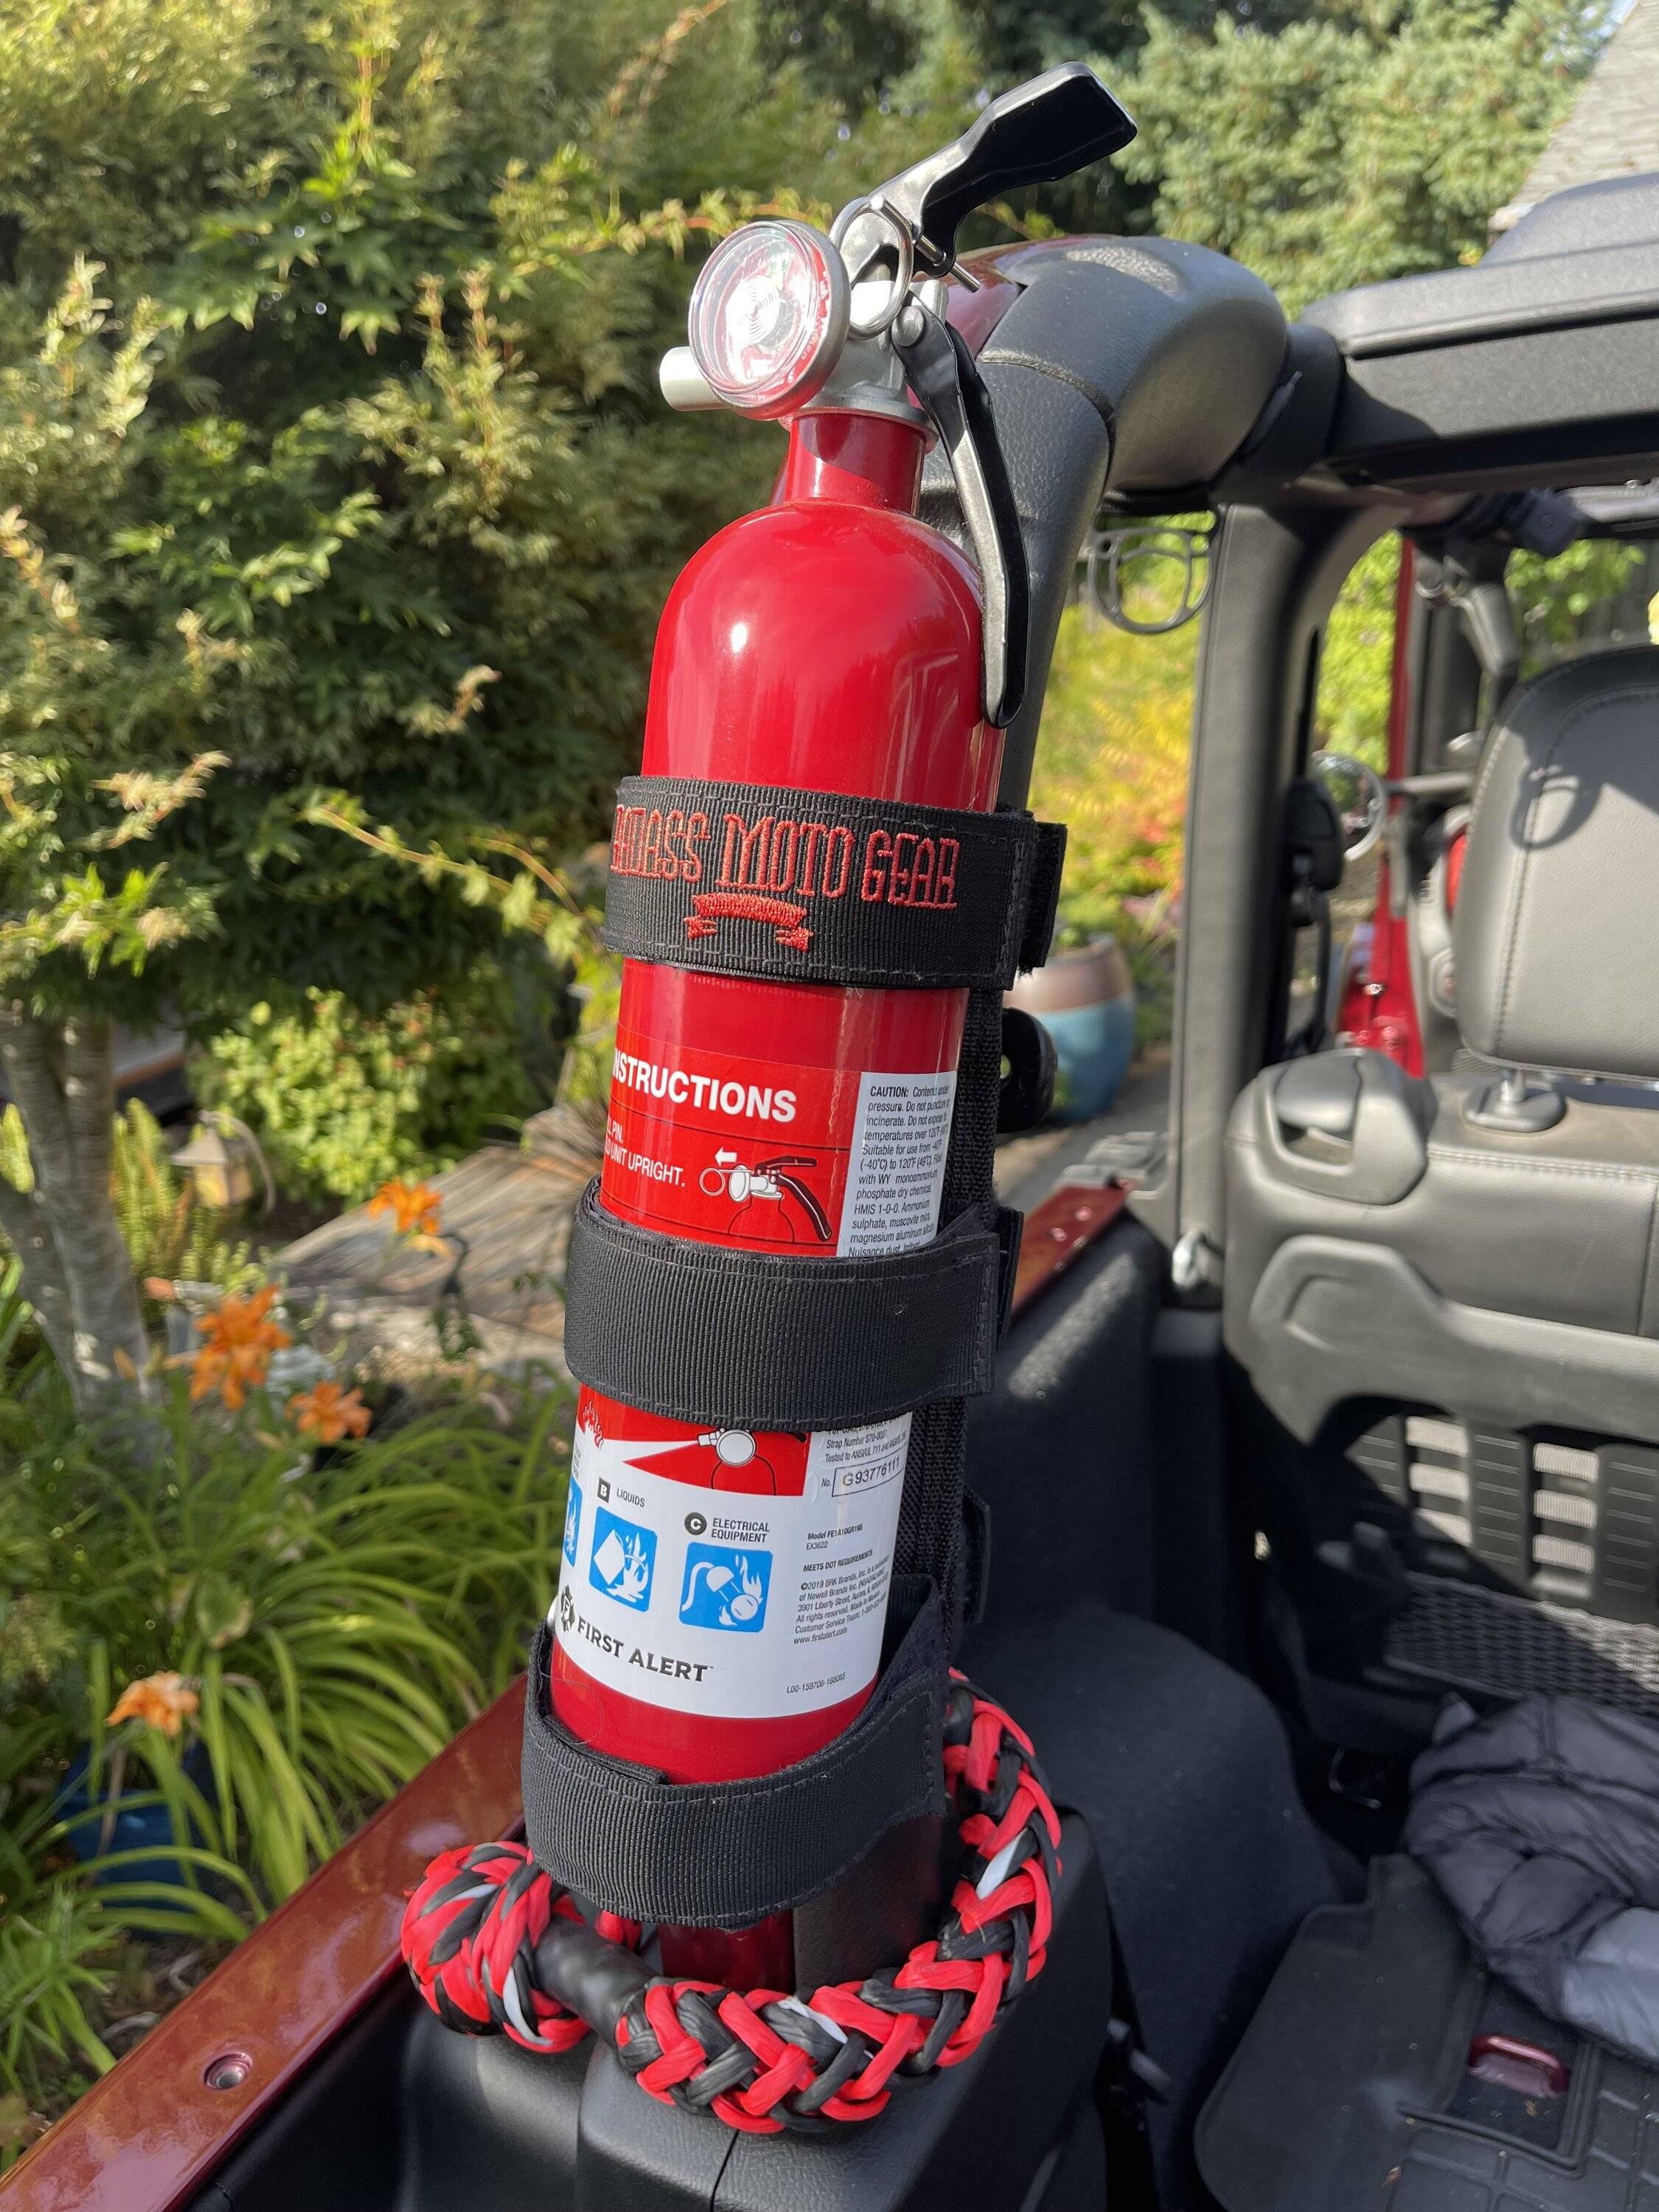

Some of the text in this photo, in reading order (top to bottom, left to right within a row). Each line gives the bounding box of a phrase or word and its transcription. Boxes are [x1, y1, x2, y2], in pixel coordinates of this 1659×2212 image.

[715, 813, 855, 898] MOTO
[861, 830, 960, 909] GEAR
[870, 1085, 909, 1098] CAUTION:
[913, 1085, 937, 1097] Contents
[868, 1102, 904, 1113] pressure.
[905, 1101, 914, 1112] Do
[917, 1101, 927, 1111] not
[866, 1114, 905, 1127] incinerate.
[908, 1115, 917, 1126] Do
[918, 1115, 928, 1125] not
[928, 1113, 943, 1125] expose
[611, 1120, 624, 1144] PIN.
[865, 1129, 914, 1142] temperatures
[915, 1130, 927, 1139] over
[863, 1144, 894, 1155] Suitable
[896, 1144, 905, 1155] for
[907, 1144, 917, 1154] use
[919, 1143, 931, 1153] from
[611, 1141, 627, 1166] UNIT
[627, 1151, 685, 1187] UPRIGHT.
[860, 1158, 888, 1172] (-40°C)
[889, 1159, 897, 1169] to
[899, 1157, 917, 1169] 120°F
[858, 1169, 938, 1185] with WY monoammonium
[856, 1188, 897, 1201] phosphate
[898, 1186, 908, 1200] dry
[854, 1199, 931, 1215] HMIS 1-0-0. Ammonium
[852, 1217, 888, 1231] sulphate,
[889, 1214, 919, 1228] muscovite
[850, 1233, 894, 1245] magnesium
[896, 1228, 922, 1242] aluminum
[849, 1245, 884, 1257] Nuisance
[827, 1439, 843, 1450] Strap
[844, 1435, 864, 1447] Number
[826, 1451, 844, 1463] Tested
[845, 1451, 851, 1460] to
[872, 1444, 881, 1455] 711
[821, 1477, 832, 1487] No.
[600, 1484, 645, 1508] B LIQUIDS
[690, 1517, 771, 1532] C ELECTRICAL
[711, 1528, 768, 1543] EQUIPMENT
[807, 1531, 827, 1540] Model
[806, 1540, 828, 1550] EX3622
[803, 1562, 824, 1573] MEETS
[825, 1560, 837, 1570] DOT
[838, 1549, 873, 1567] REQUIREMENTS
[825, 1577, 838, 1587] BRK
[799, 1593, 807, 1601] of
[807, 1590, 827, 1601] Newell
[829, 1586, 848, 1597] Brands
[798, 1603, 813, 1613] 3901
[815, 1599, 834, 1610] Liberty
[796, 1614, 805, 1623] All
[806, 1611, 824, 1623] rights
[824, 1606, 849, 1618] reserved.
[795, 1622, 824, 1634] Customer
[825, 1617, 846, 1627] Service
[577, 1614, 625, 1658] FIRST
[793, 1627, 848, 1645] www.firstalert.com
